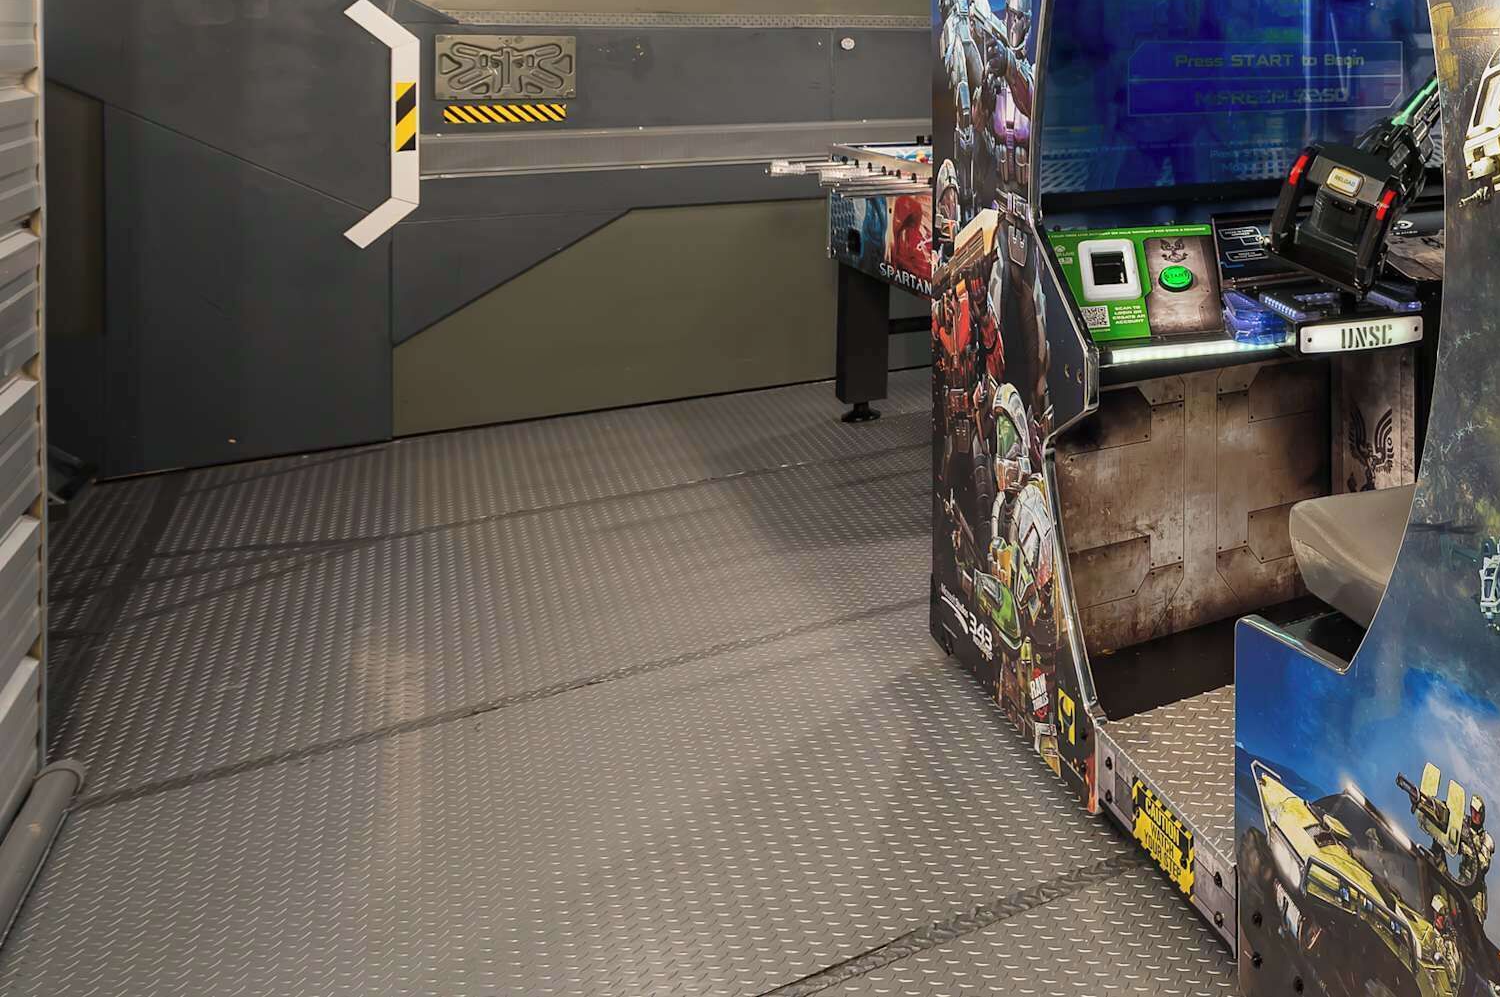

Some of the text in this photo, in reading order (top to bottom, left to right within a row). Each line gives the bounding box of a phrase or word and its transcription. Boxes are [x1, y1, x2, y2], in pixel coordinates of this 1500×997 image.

[1175, 54, 1365, 69] Press START to Begin
[879, 262, 932, 295] SPARTAN
[1341, 323, 1393, 349] UNSC
[968, 611, 993, 652] 343
[1145, 796, 1180, 847] CAUTION
